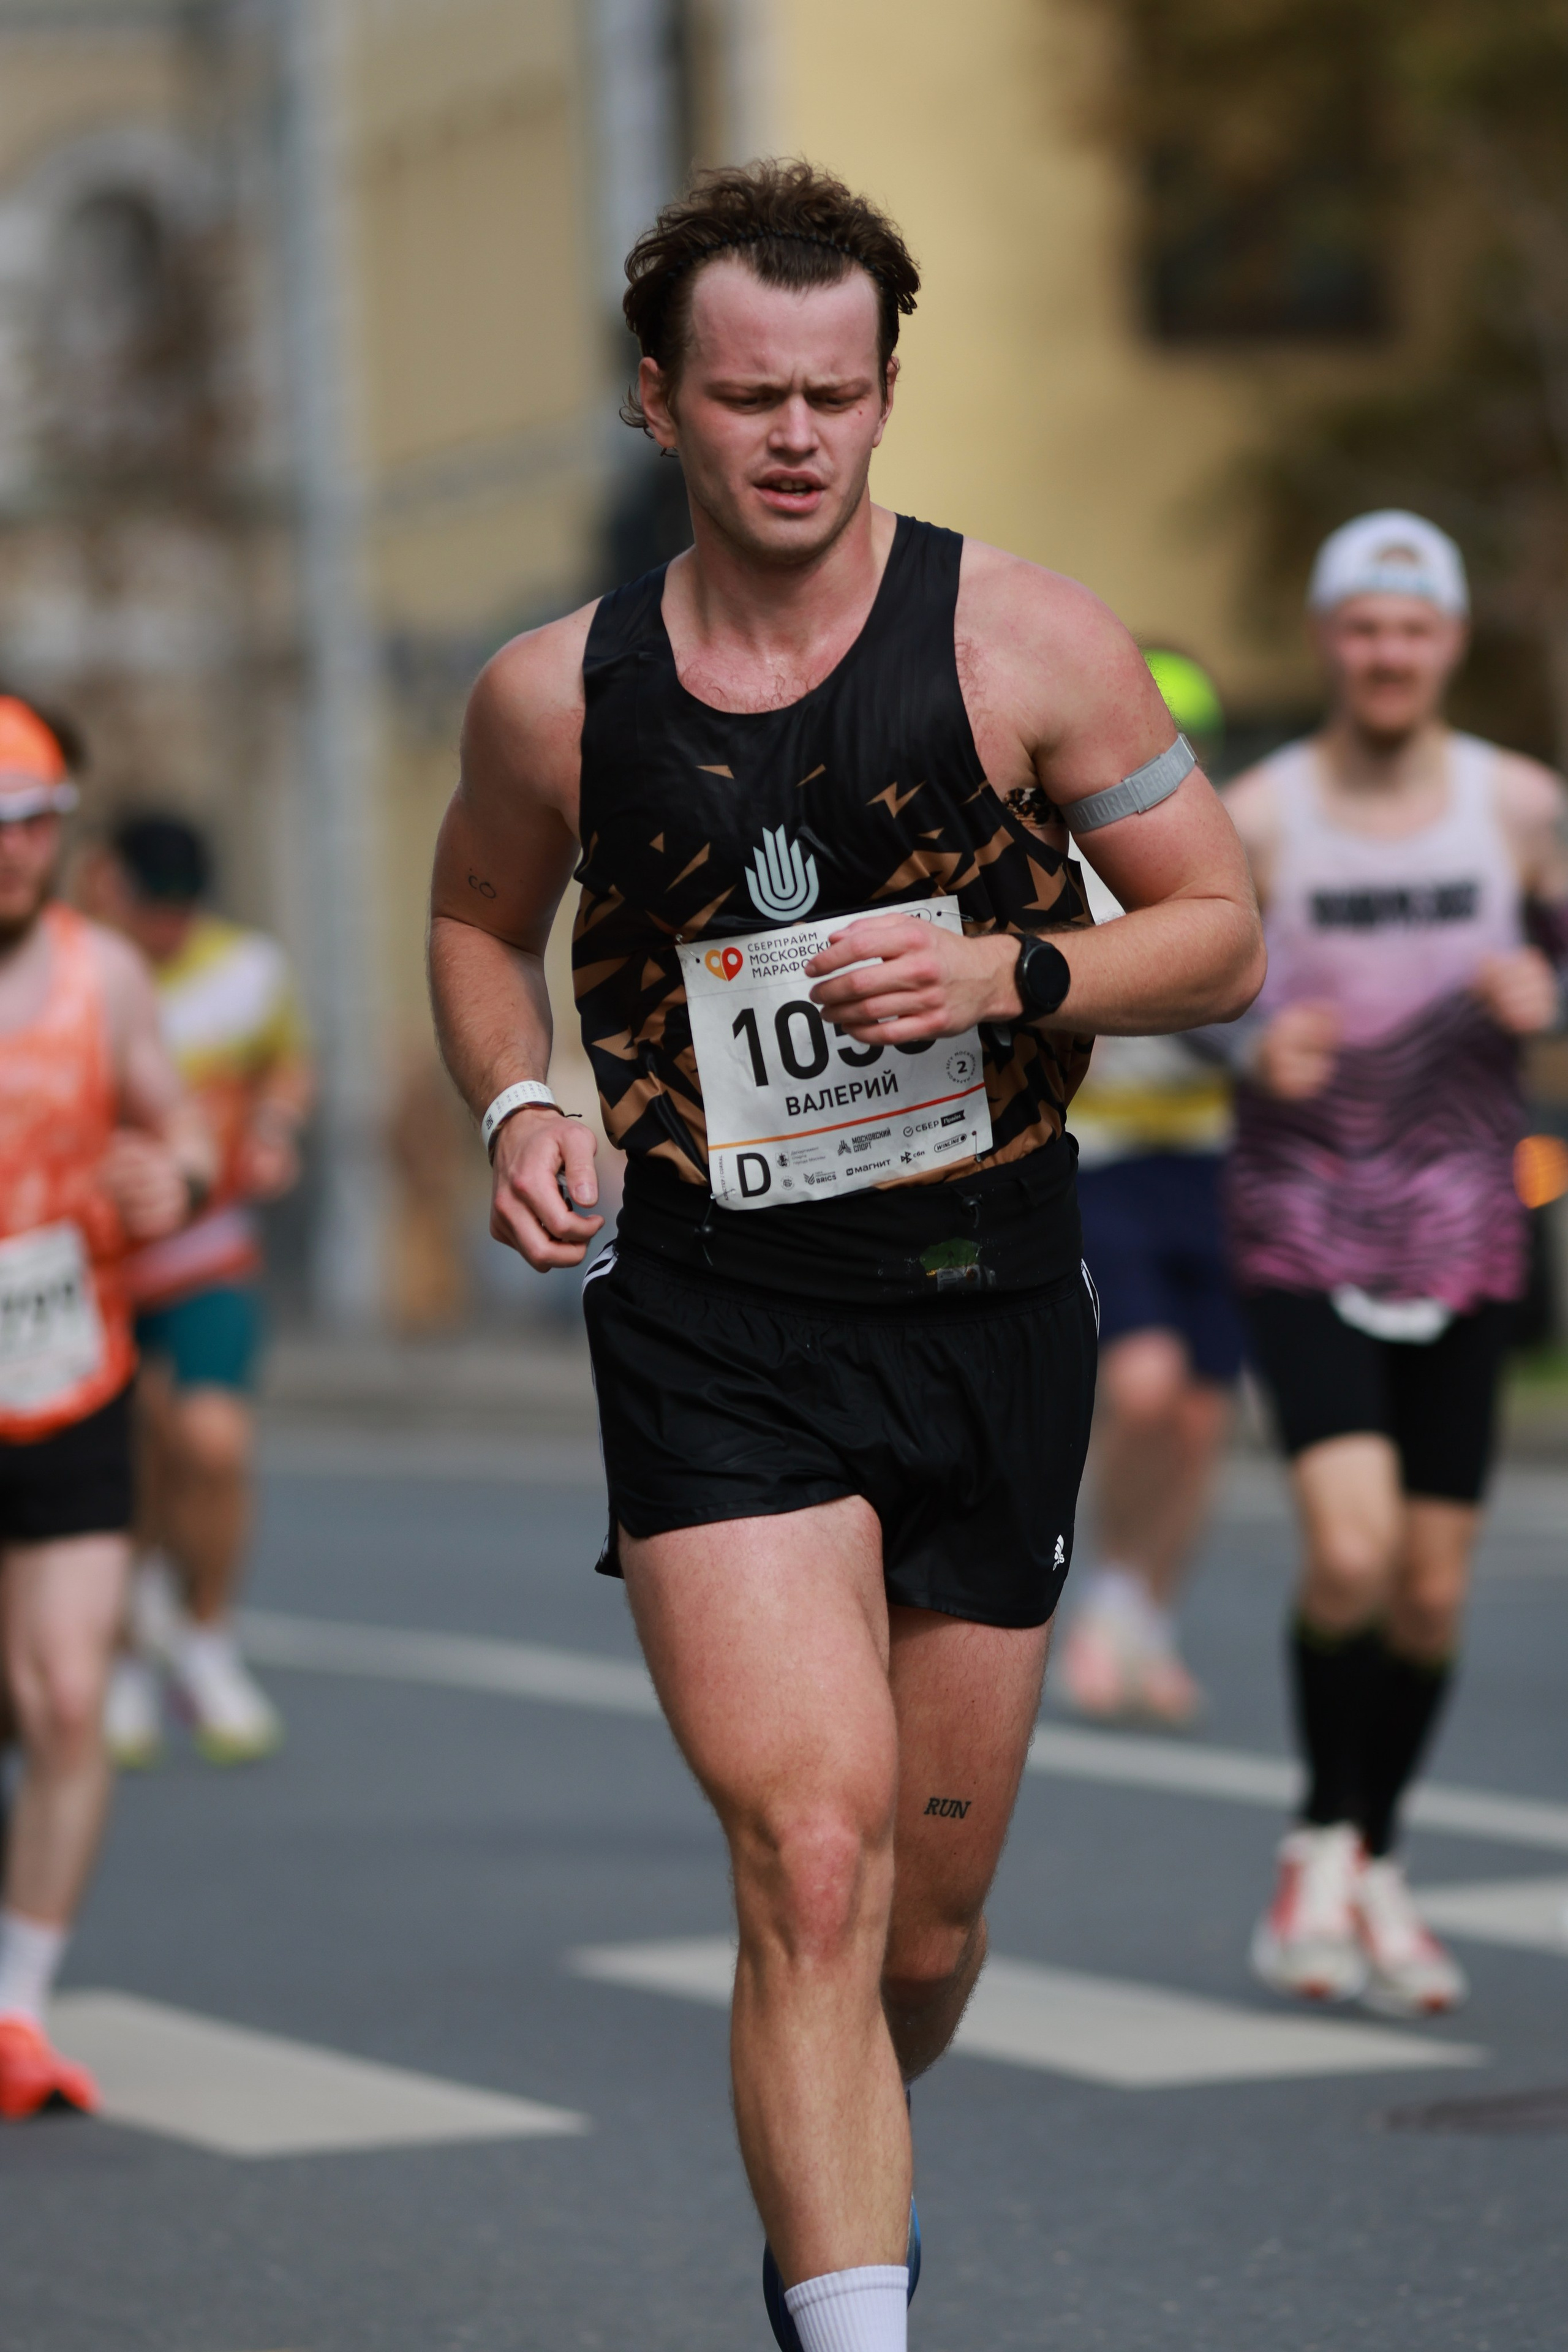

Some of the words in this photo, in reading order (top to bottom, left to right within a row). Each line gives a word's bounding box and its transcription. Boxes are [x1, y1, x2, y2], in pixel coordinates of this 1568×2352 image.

[747, 932, 818, 952] СБЕРПРАЙМ
[752, 958, 811, 978] МАРАФО
[732, 1000, 937, 1087] 105
[957, 1060, 968, 1074] 2
[786, 1069, 899, 1116] ВАЛЕРИЙ
[851, 1126, 891, 1144] МОСКОВСКИЙ
[915, 1120, 939, 1133] СБЕР
[853, 1141, 872, 1153] СПОРТ
[937, 1138, 959, 1150] WINLINE
[736, 1152, 771, 1198] D
[816, 1175, 837, 1183] BRICS
[924, 1797, 972, 1819] RUN
